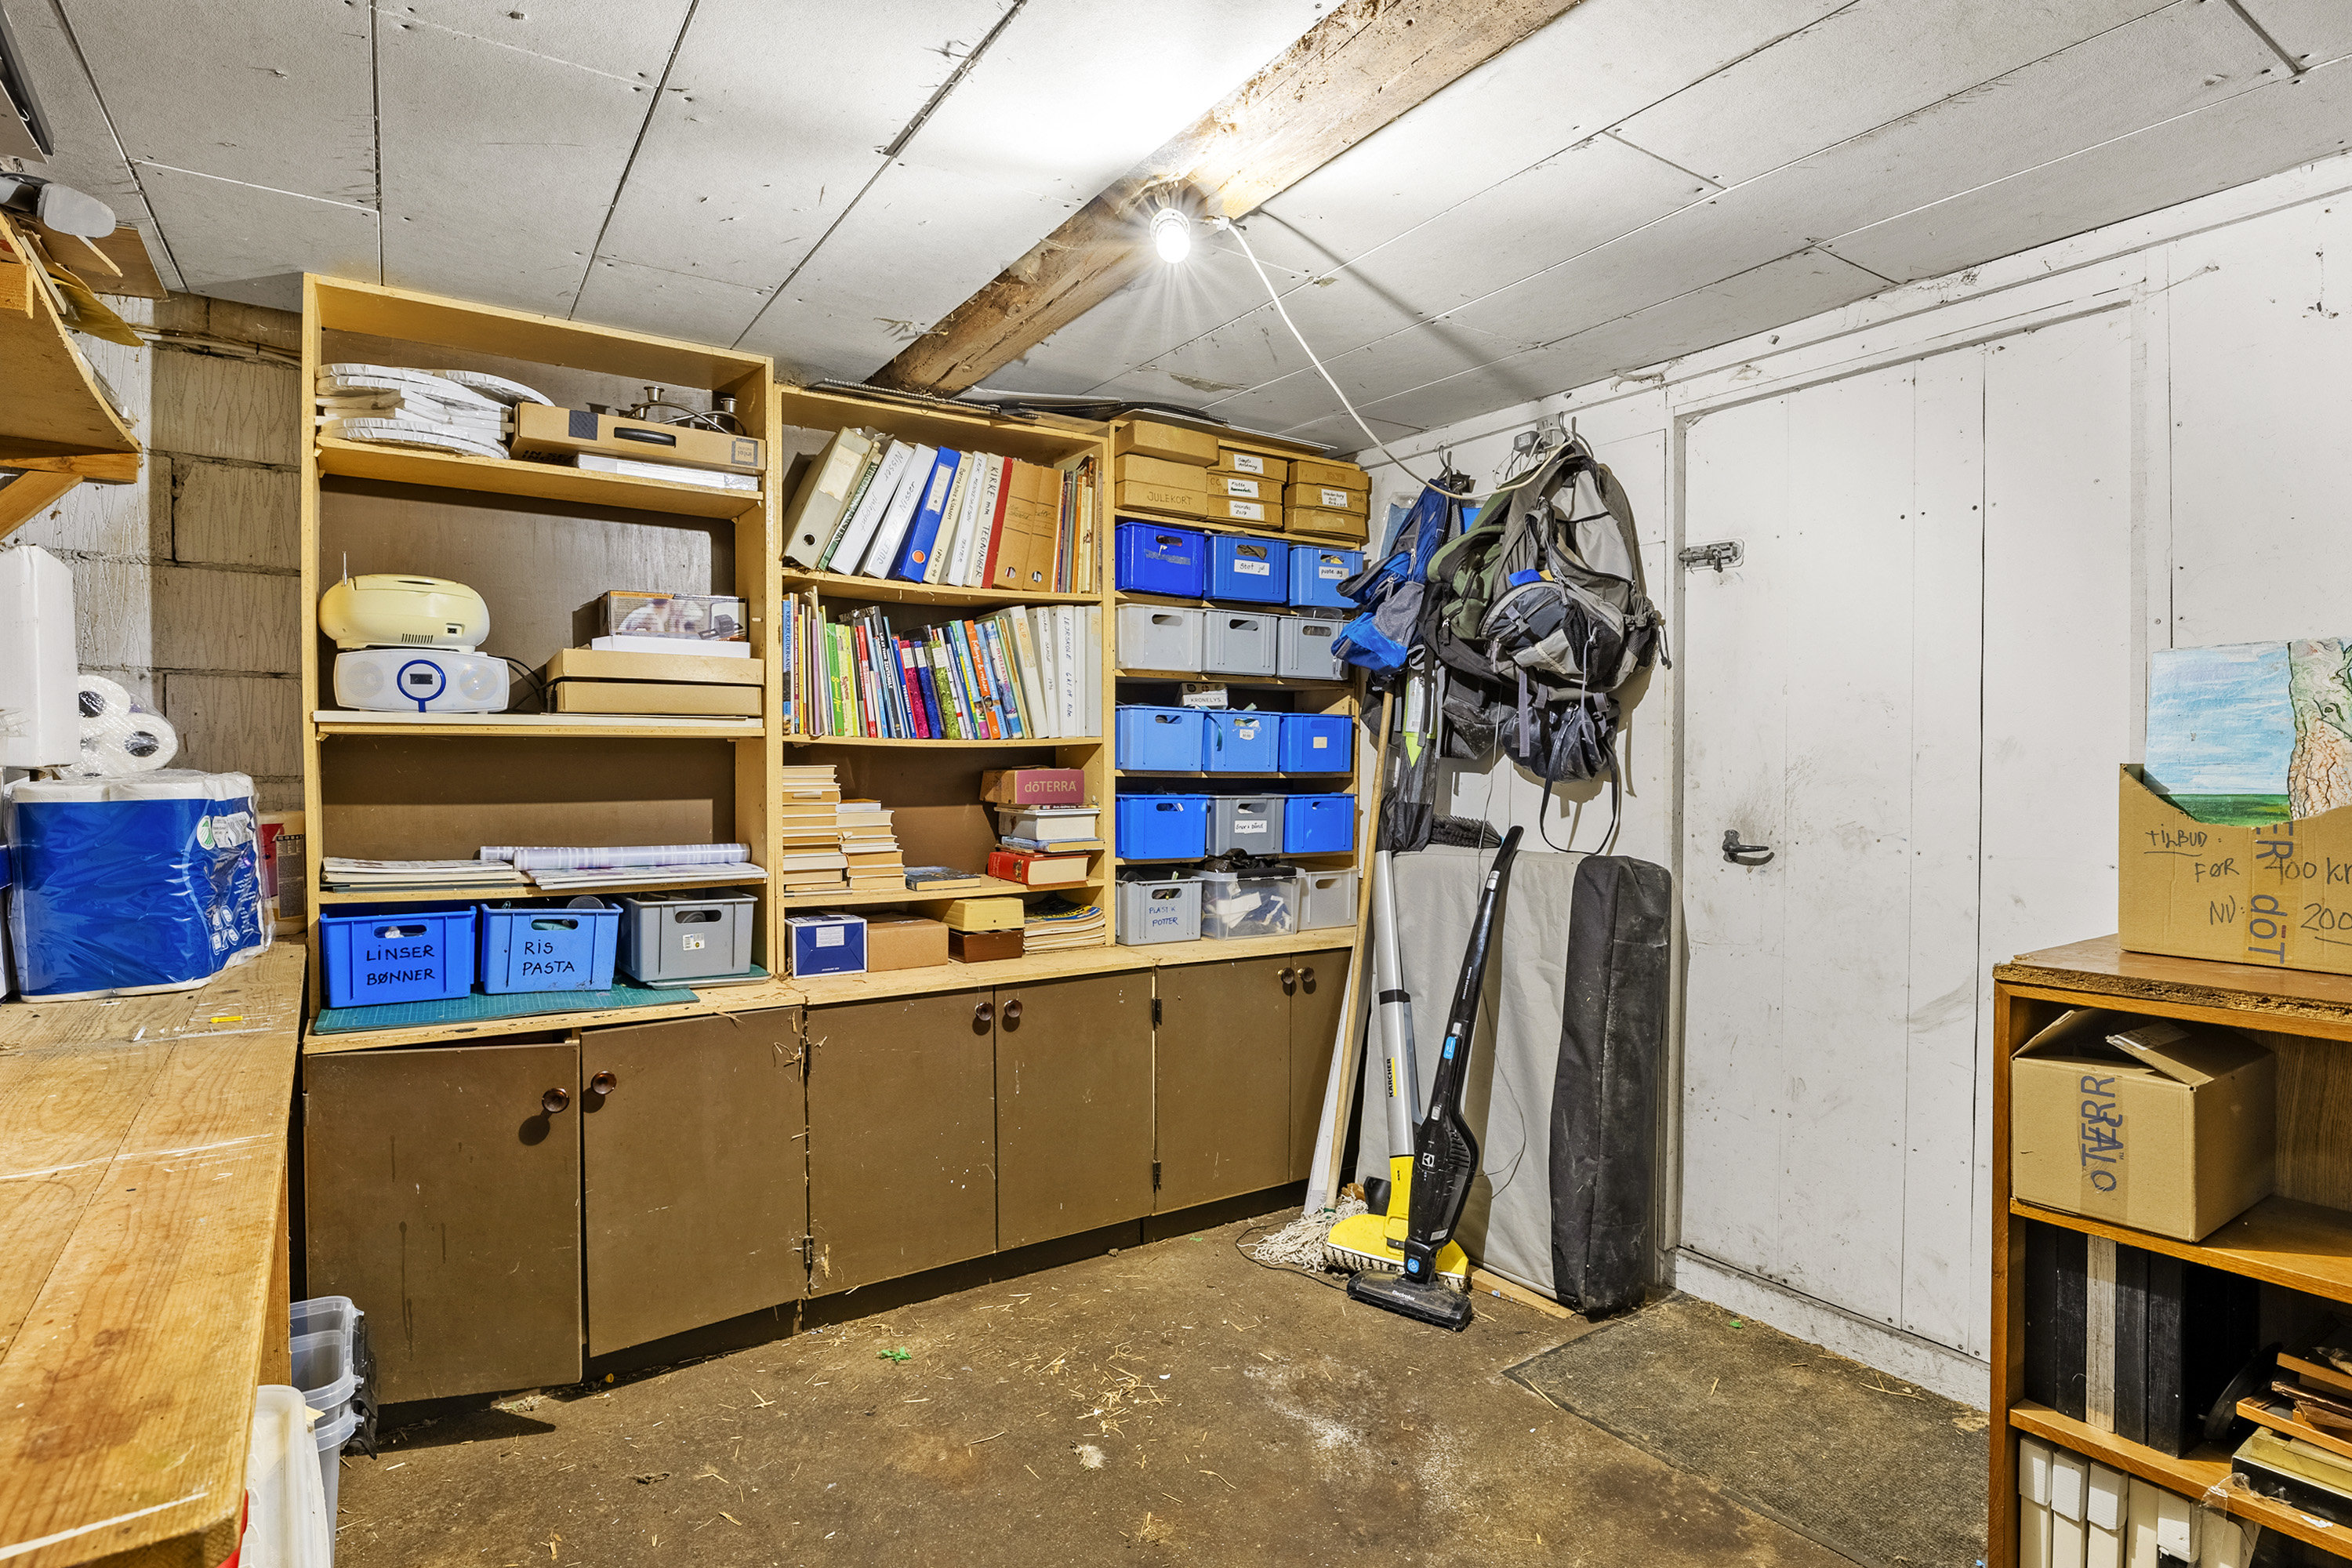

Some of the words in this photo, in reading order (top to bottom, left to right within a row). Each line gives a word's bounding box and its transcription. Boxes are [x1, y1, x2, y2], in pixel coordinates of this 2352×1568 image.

[1147, 492, 1192, 506] JULEKORT
[1017, 622, 1029, 638] KLIP
[1062, 616, 1073, 660] LEJRSKOLE
[882, 660, 894, 688] ZENTANGLE
[2195, 858, 2241, 883] FØR
[2264, 856, 2318, 885] 400
[1152, 916, 1179, 927] POTTER
[366, 967, 436, 987] BØNNER
[522, 960, 575, 977] PASTA
[1392, 1290, 1416, 1301] Electrolux
